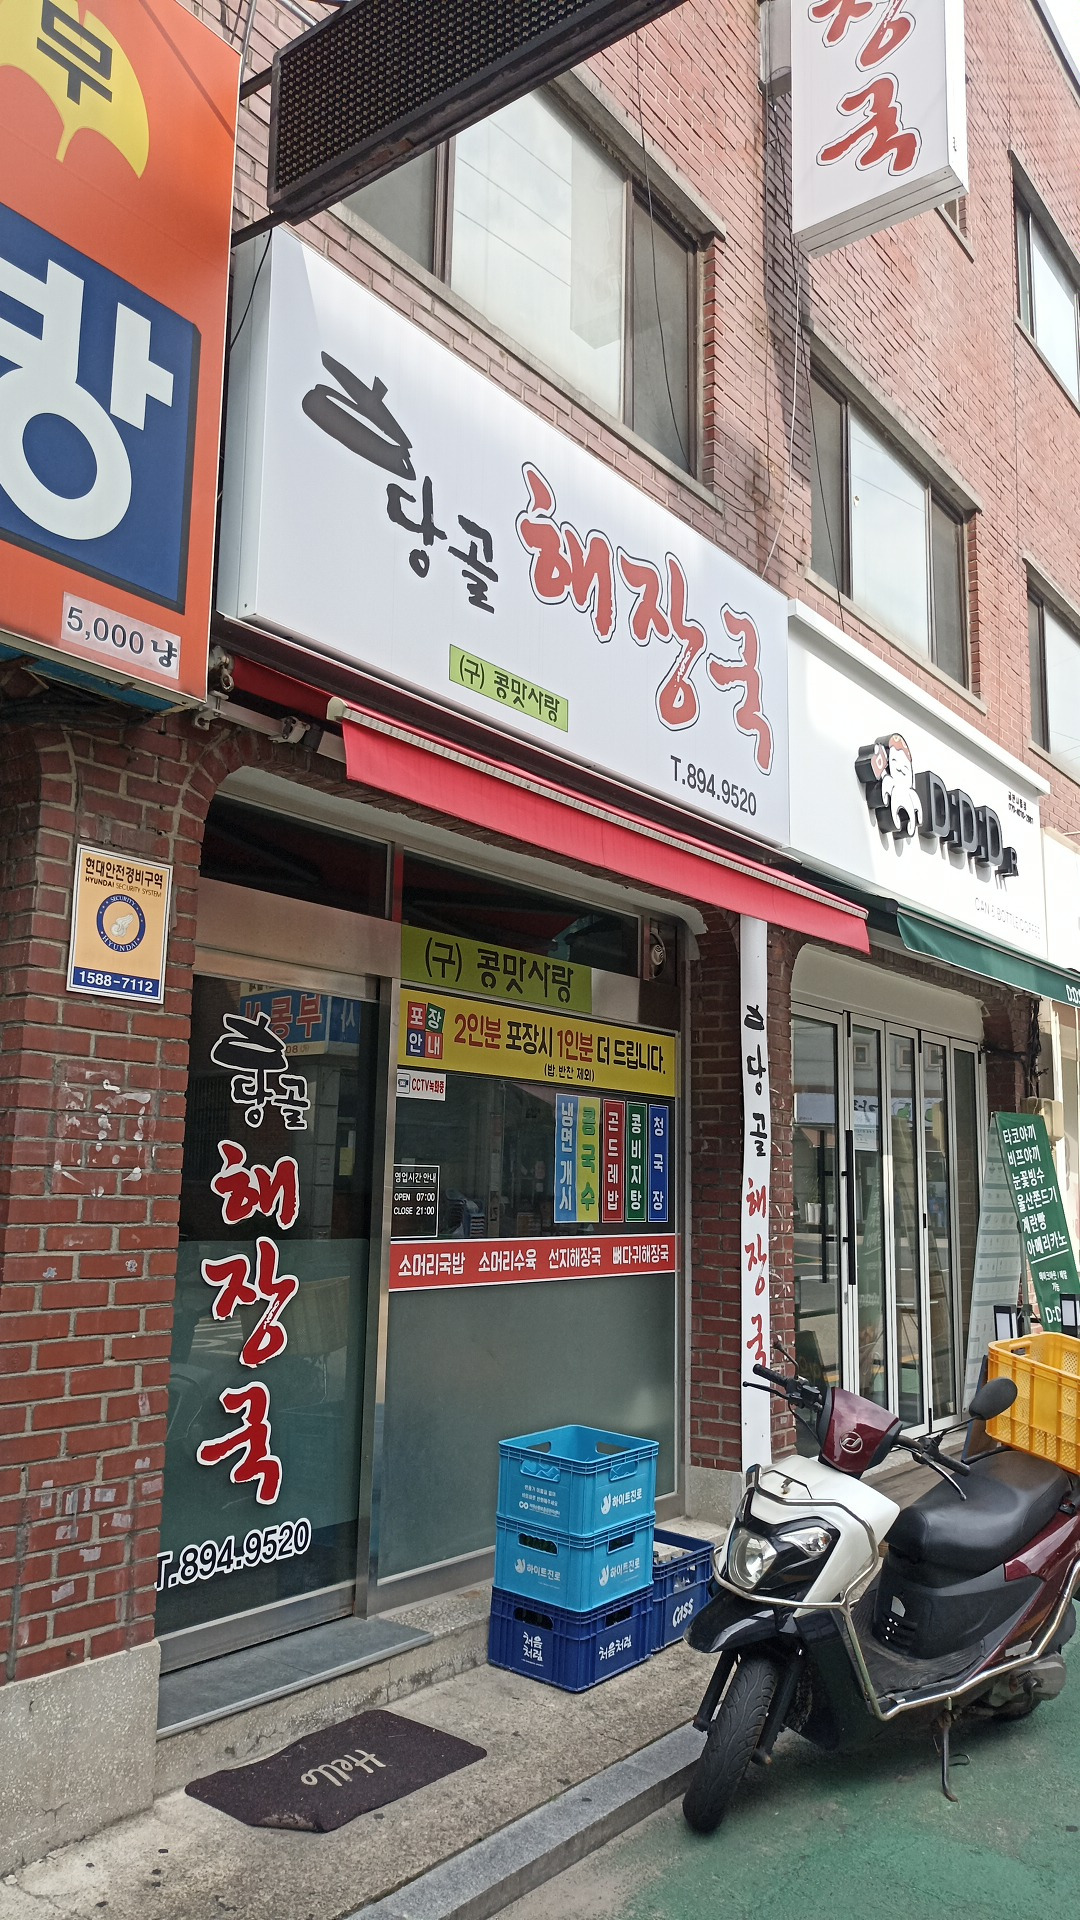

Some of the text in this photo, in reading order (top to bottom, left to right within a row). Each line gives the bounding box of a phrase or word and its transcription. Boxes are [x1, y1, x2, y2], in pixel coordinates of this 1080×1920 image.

[66, 606, 144, 655] 5,000
[516, 462, 774, 775] 해장국
[459, 654, 560, 723] (구) 콩맛사랑
[670, 754, 757, 816] T.894.9520
[85, 857, 163, 890] 현대안전경비구역
[85, 876, 162, 898] HYUNDAI SECURITY SYSTEM
[110, 895, 136, 907] SECURITY
[102, 934, 138, 952] HYUNDAI
[79, 970, 153, 993] 1588-7112
[425, 937, 574, 1004] (구) 콩맛사랑
[409, 1006, 443, 1031] 포장
[408, 1032, 442, 1057] 안내
[454, 1013, 666, 1075] 2인분 포장시 1인분 더 드립니다.
[1002, 1123, 1037, 1145] 타코야끼
[559, 1102, 574, 1211] 냉면 개시
[581, 1106, 596, 1211] 콩국수
[607, 1111, 619, 1211] 곤드레밥
[630, 1113, 642, 1210] 콩비지탕
[652, 1116, 664, 1211] 청국장
[1006, 1144, 1041, 1167] 비프야끼
[394, 1172, 437, 1183] 영업시간 안내
[1012, 1166, 1045, 1190] 눈꽃빙수
[394, 1192, 435, 1201] OPEN 07:00
[393, 1206, 435, 1216] CLOSE 21:00
[1021, 1211, 1047, 1234] 계란빵
[1026, 1230, 1068, 1257] 아메리카노
[398, 1244, 670, 1276] 소머리국밥 소머리수육 선지해장국 뼈다귀해장국
[744, 1177, 767, 1369] 해장국
[197, 1138, 301, 1506] 해장국
[612, 1487, 643, 1508] 하이트진로
[526, 1562, 561, 1582] 하이트진로
[610, 1557, 640, 1579] 하이트진로
[672, 1597, 694, 1629] Cass
[522, 1645, 543, 1662] 처럼
[523, 1631, 543, 1649] 처음
[598, 1634, 632, 1661] 처음처럼
[300, 1749, 386, 1787] Hello
